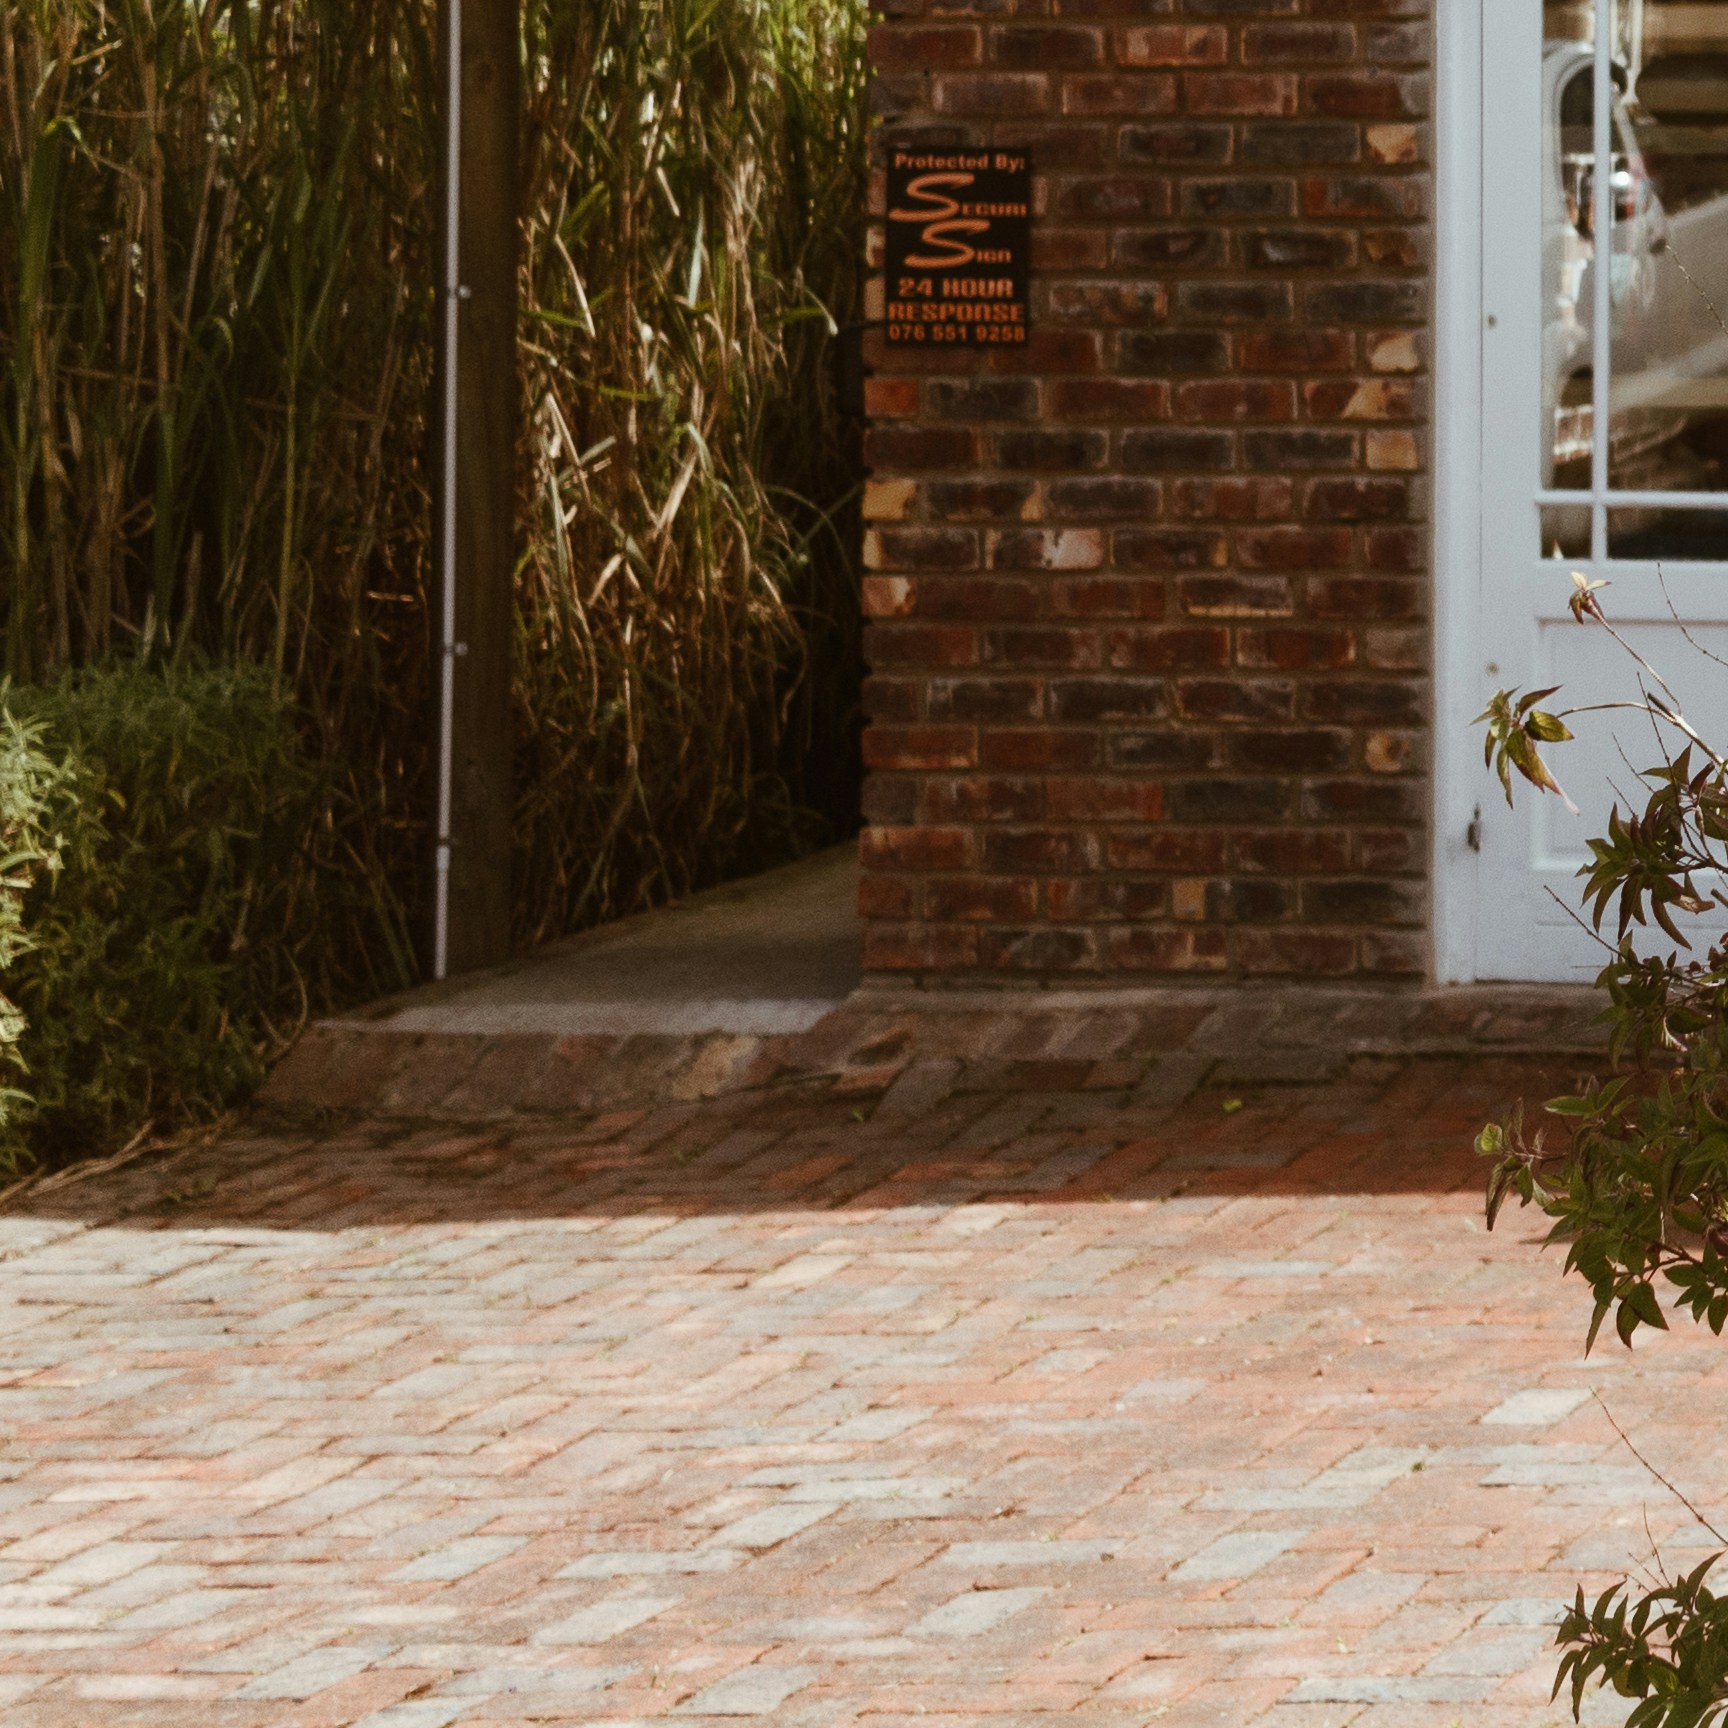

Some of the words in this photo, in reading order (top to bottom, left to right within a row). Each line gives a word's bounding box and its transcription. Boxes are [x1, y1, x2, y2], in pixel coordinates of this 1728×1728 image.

[894, 153, 988, 170] Protected
[995, 153, 1025, 173] By:
[899, 276, 933, 297] 24
[943, 276, 1013, 298] HOUR
[888, 301, 1025, 322] RESPONSE
[889, 324, 925, 342] 076
